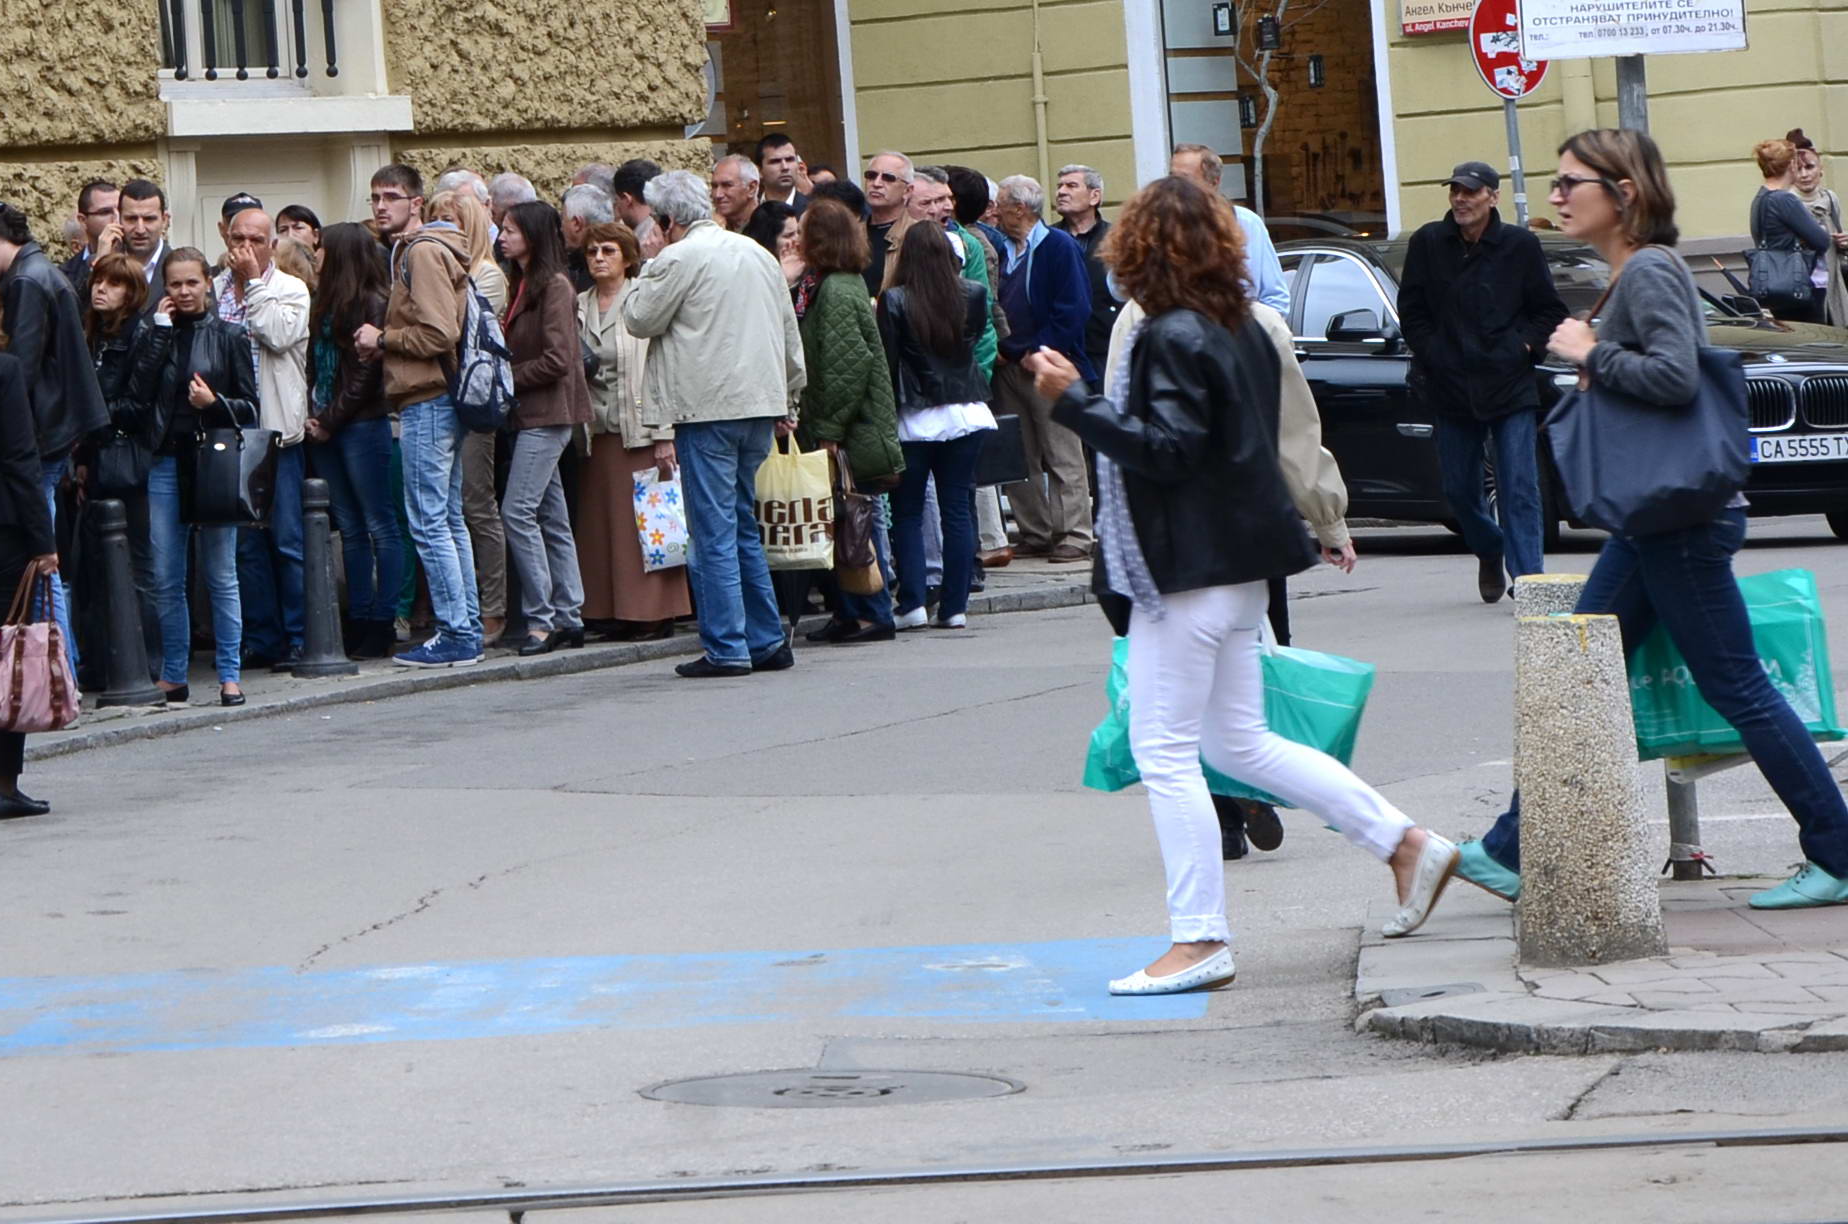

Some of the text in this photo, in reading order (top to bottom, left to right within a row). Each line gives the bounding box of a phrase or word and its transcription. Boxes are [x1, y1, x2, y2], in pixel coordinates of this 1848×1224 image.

[1405, 4, 1435, 17] Ангел
[1570, 0, 1672, 13] НАРУШИТЕЛИТЕ
[1532, 9, 1734, 27] ОТСТРАНЯВАТ ПРИНУДИТЕЛНО!
[1415, 22, 1435, 33] Angel
[1761, 440, 1784, 459] CA
[1787, 437, 1830, 457] 5555
